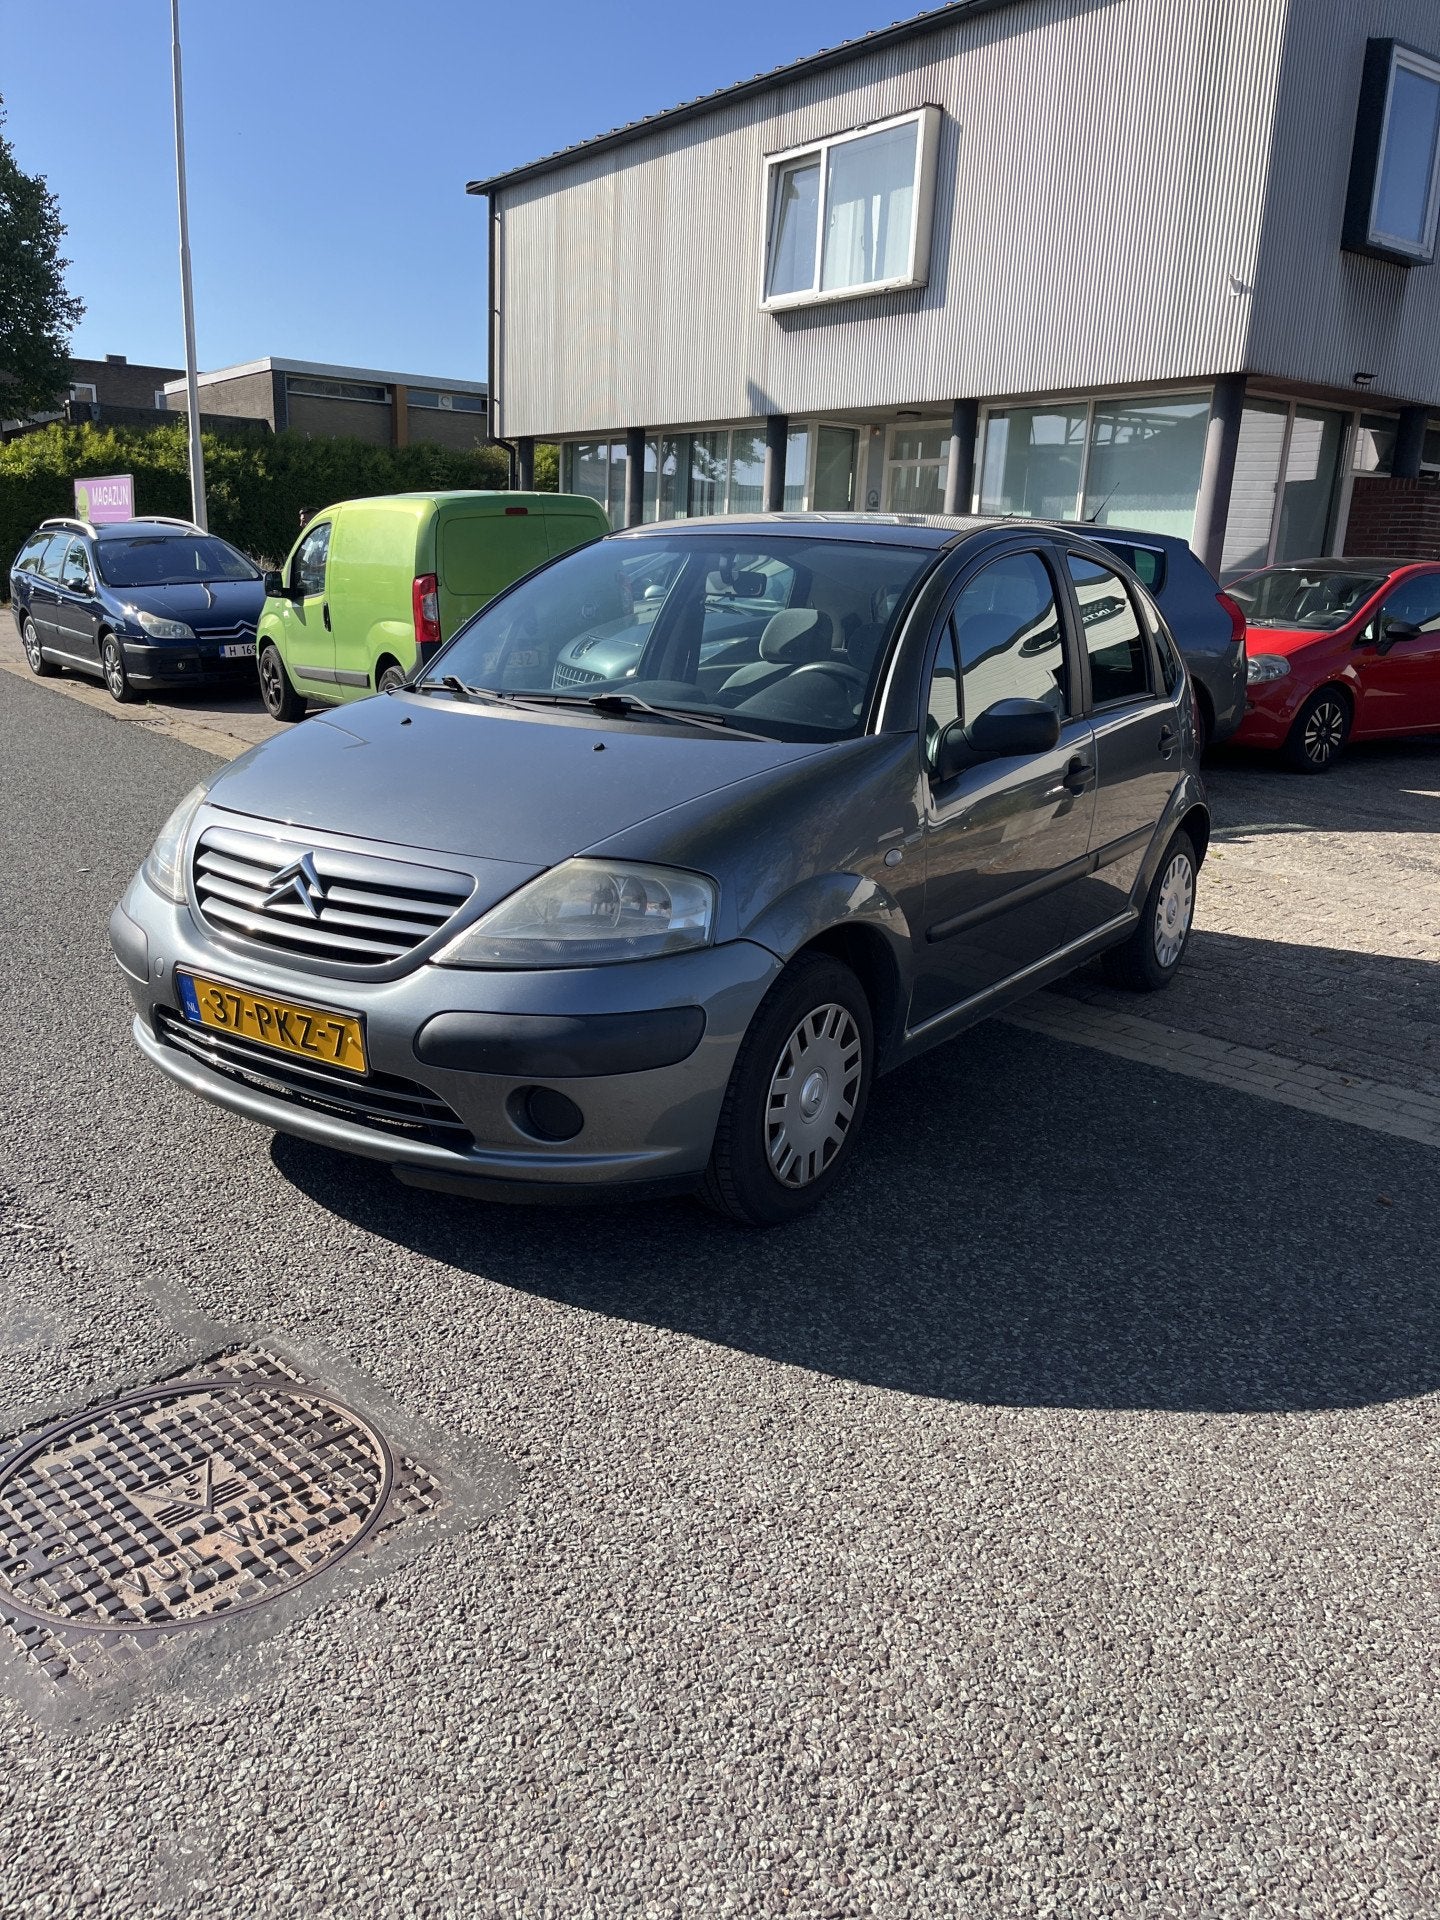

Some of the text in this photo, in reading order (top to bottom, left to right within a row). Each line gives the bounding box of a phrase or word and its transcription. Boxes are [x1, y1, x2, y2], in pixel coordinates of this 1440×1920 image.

[92, 485, 129, 506] MAGAZIJN
[229, 646, 237, 656] H
[186, 987, 346, 1058] NL 37-PKZ-7
[121, 1480, 351, 1597] VUIL WATER
